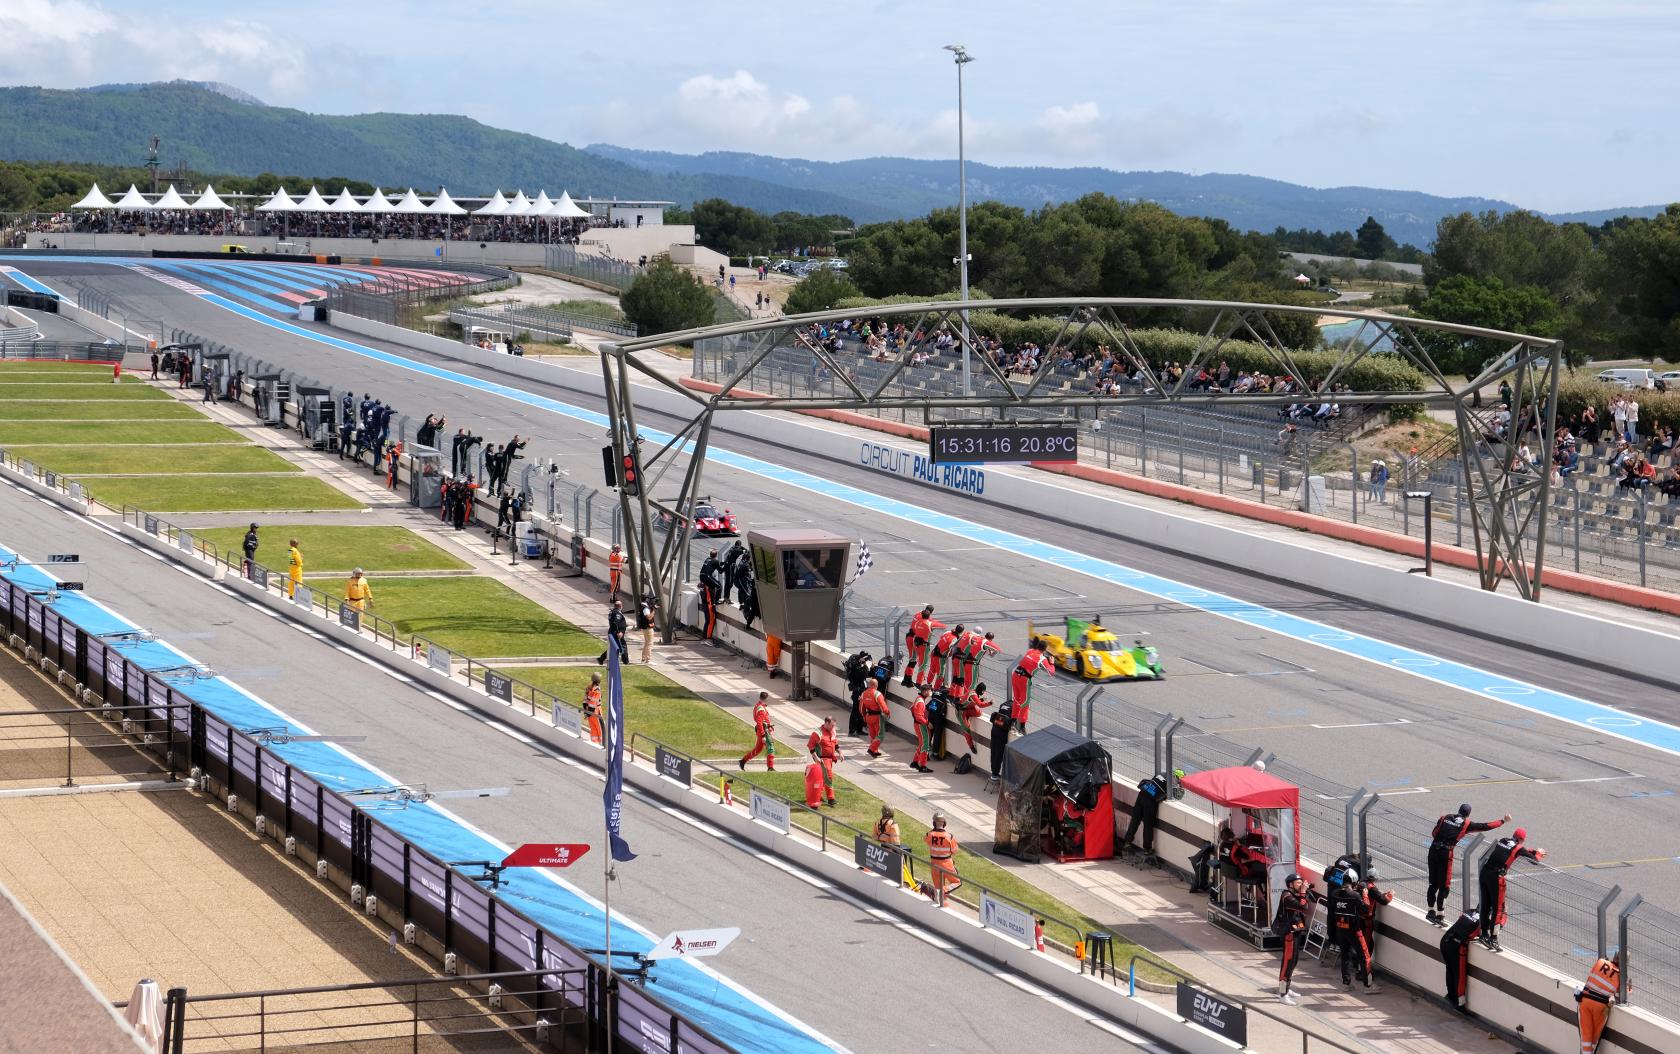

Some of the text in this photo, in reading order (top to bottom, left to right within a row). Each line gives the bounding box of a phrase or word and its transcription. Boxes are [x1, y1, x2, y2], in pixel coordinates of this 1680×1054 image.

[939, 437, 1011, 453] 15:31:16
[860, 443, 910, 474] CIRCUIT
[943, 465, 985, 494] RICARD
[931, 836, 946, 848] RT
[687, 940, 717, 949] NIELSEN
[1599, 962, 1620, 978] RT
[1193, 993, 1228, 1018] ELMS
